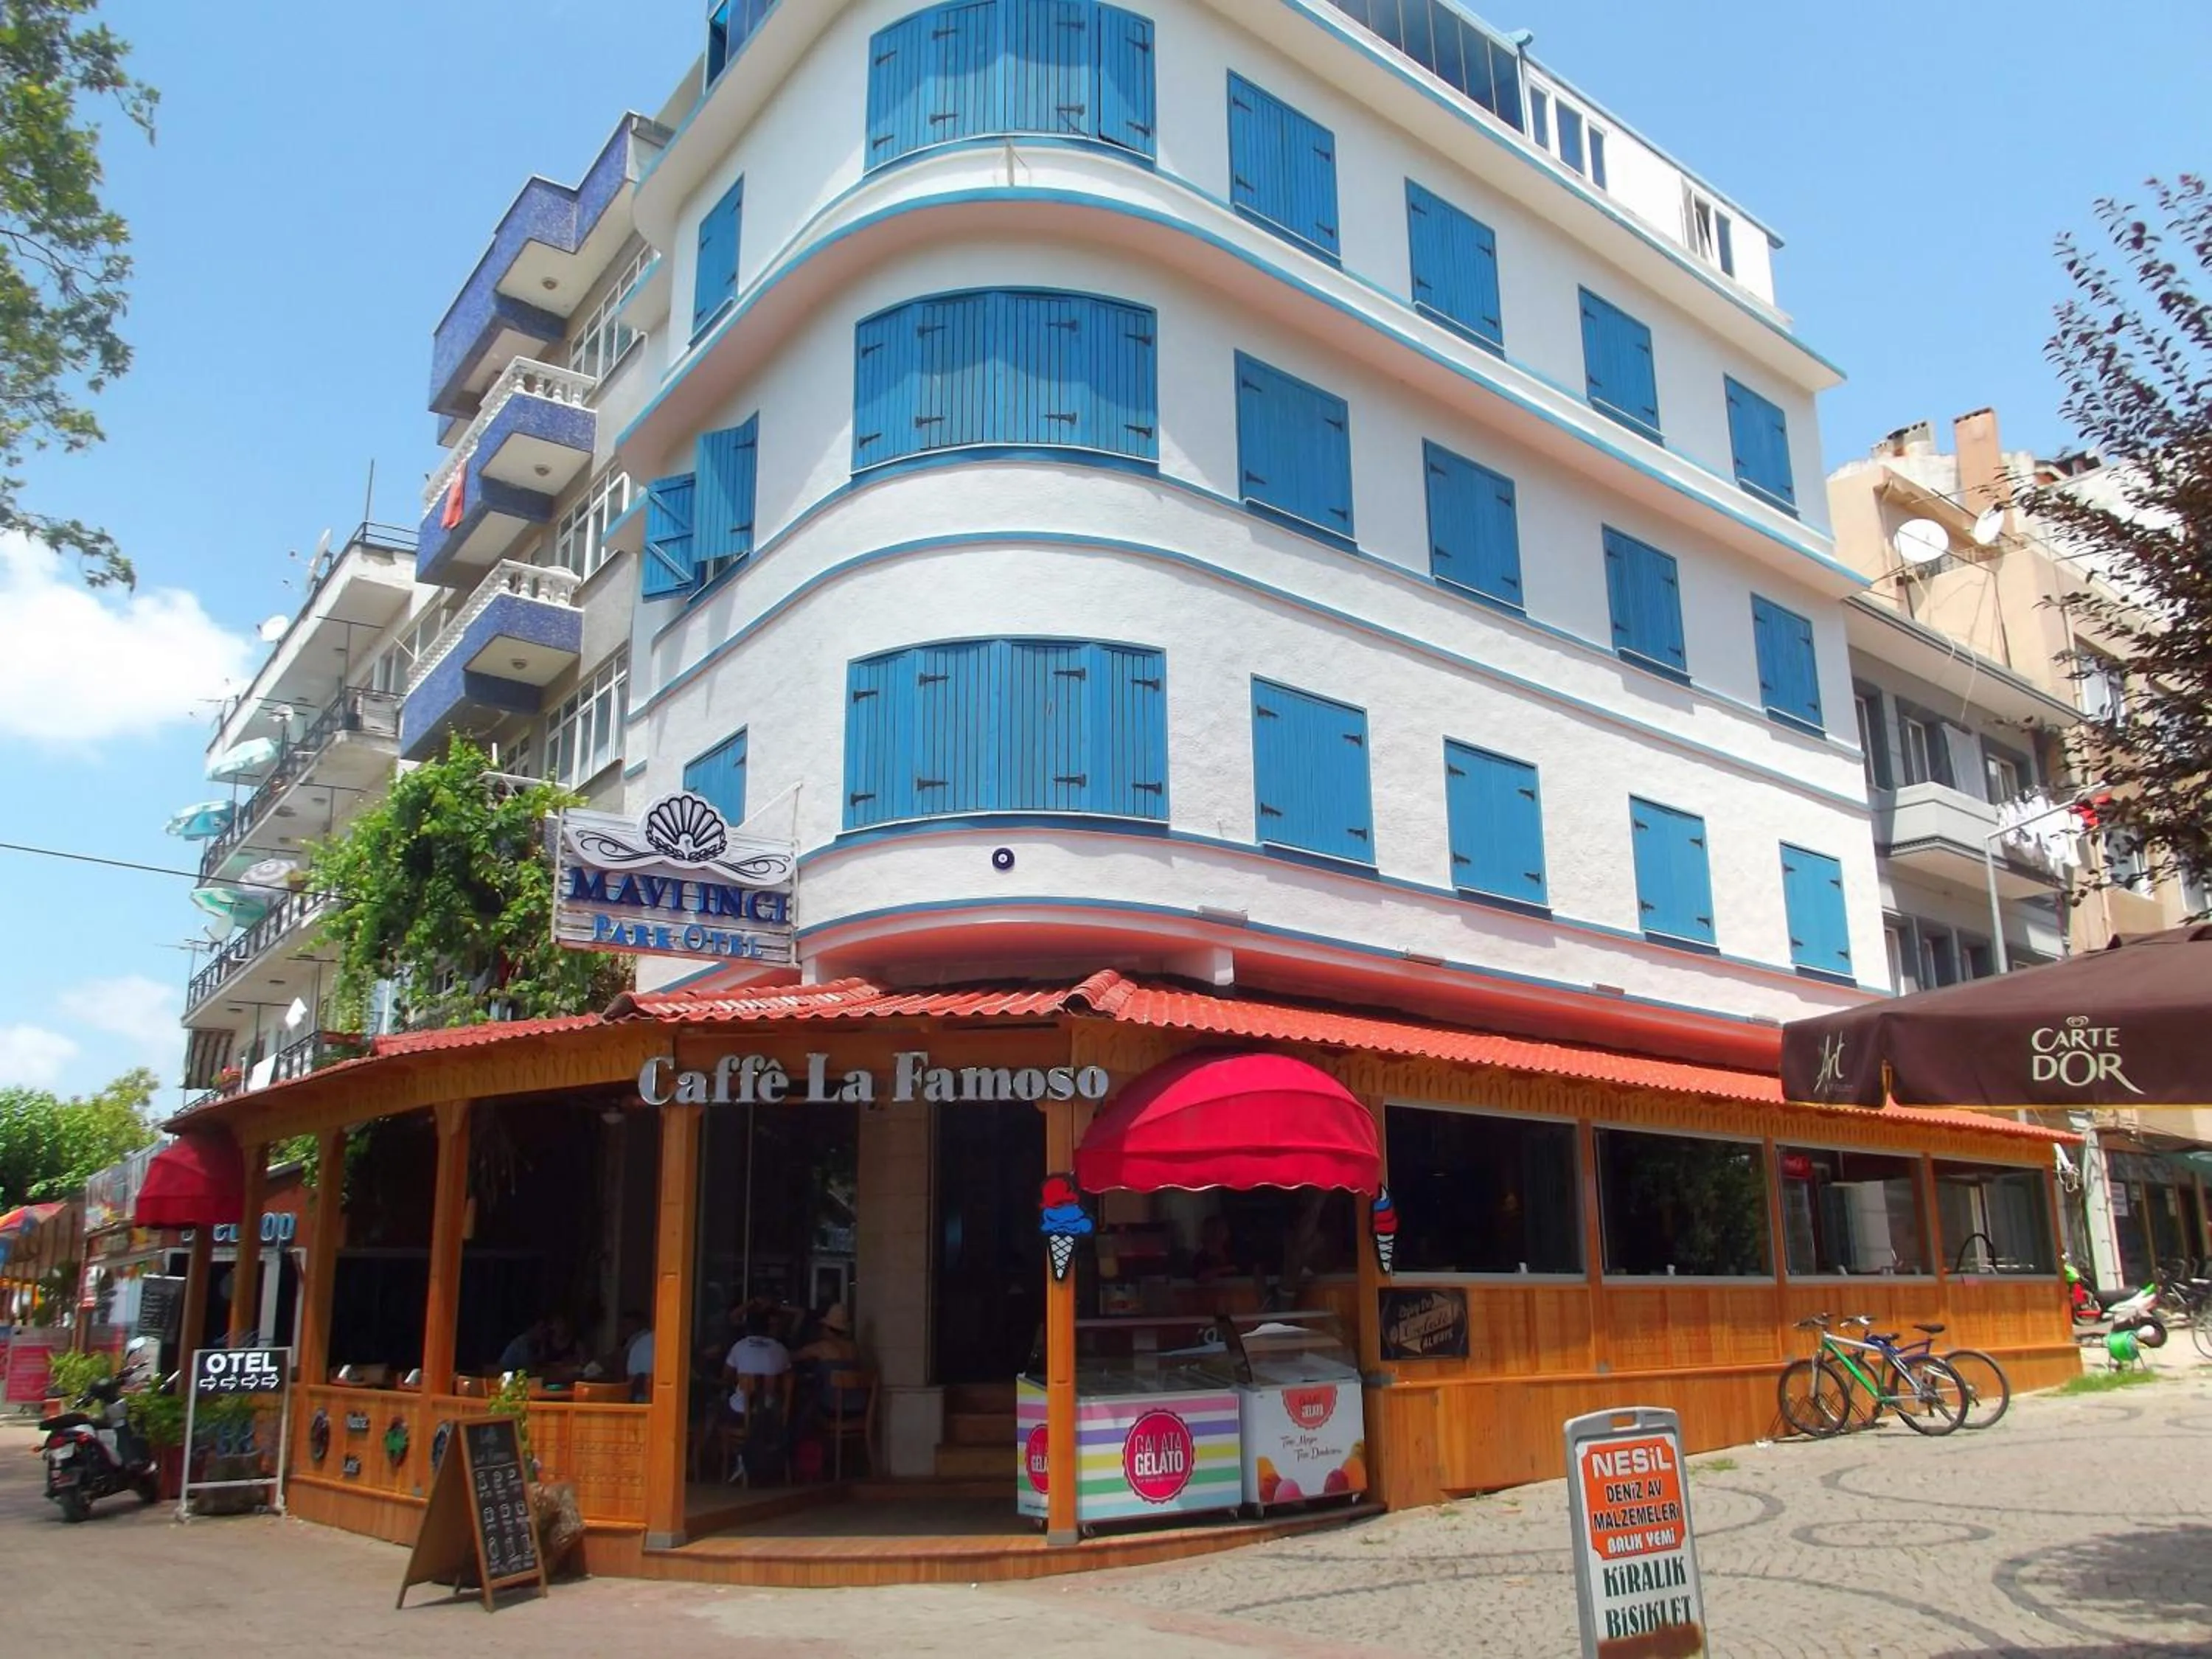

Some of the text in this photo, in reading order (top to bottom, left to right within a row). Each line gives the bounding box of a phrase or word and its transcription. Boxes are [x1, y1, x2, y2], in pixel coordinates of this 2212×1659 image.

[593, 913, 764, 958] PARK OTEL
[2031, 1027, 2121, 1052] CARTE
[805, 1052, 876, 1102] La
[892, 1051, 1109, 1102] Famoso
[2032, 1051, 2146, 1095] D'OR
[206, 1352, 278, 1373] OTEL
[1135, 1450, 1183, 1476] GELATO
[1648, 1479, 1662, 1496] AV
